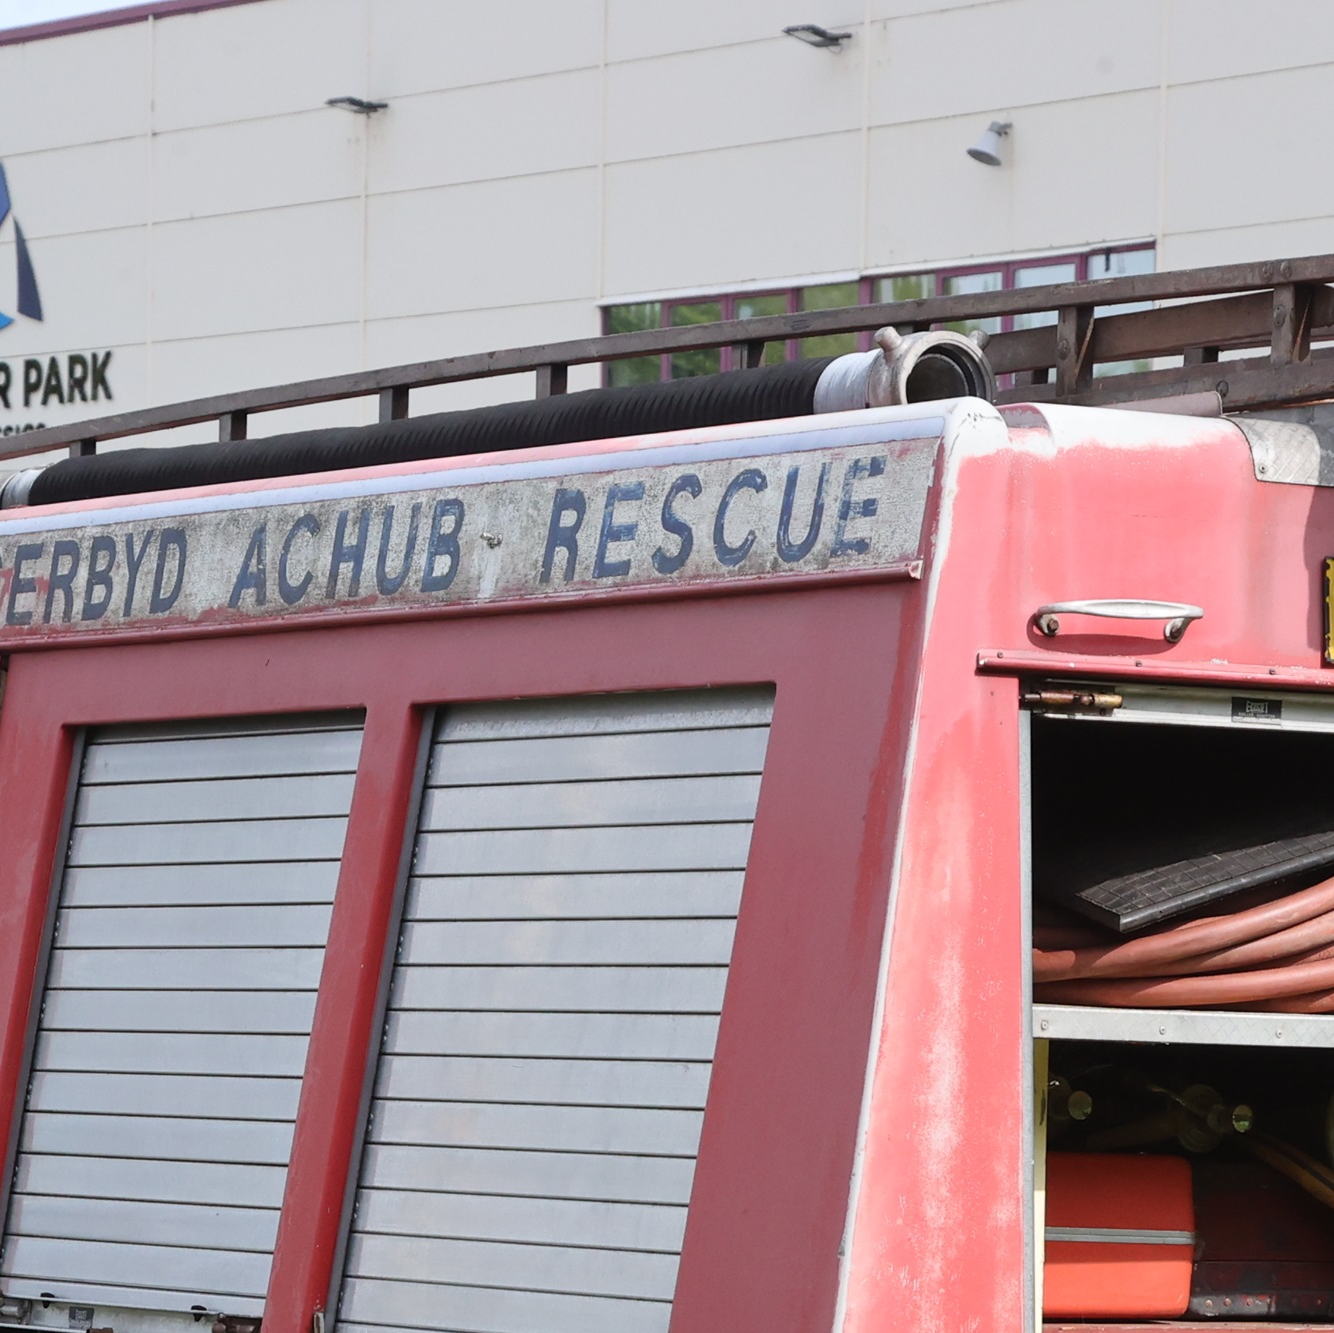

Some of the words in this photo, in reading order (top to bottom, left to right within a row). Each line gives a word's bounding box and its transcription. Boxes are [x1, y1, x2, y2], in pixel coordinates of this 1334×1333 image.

[23, 350, 113, 408] PARK
[229, 496, 467, 609] ACHUB
[539, 455, 888, 585] RESCUE
